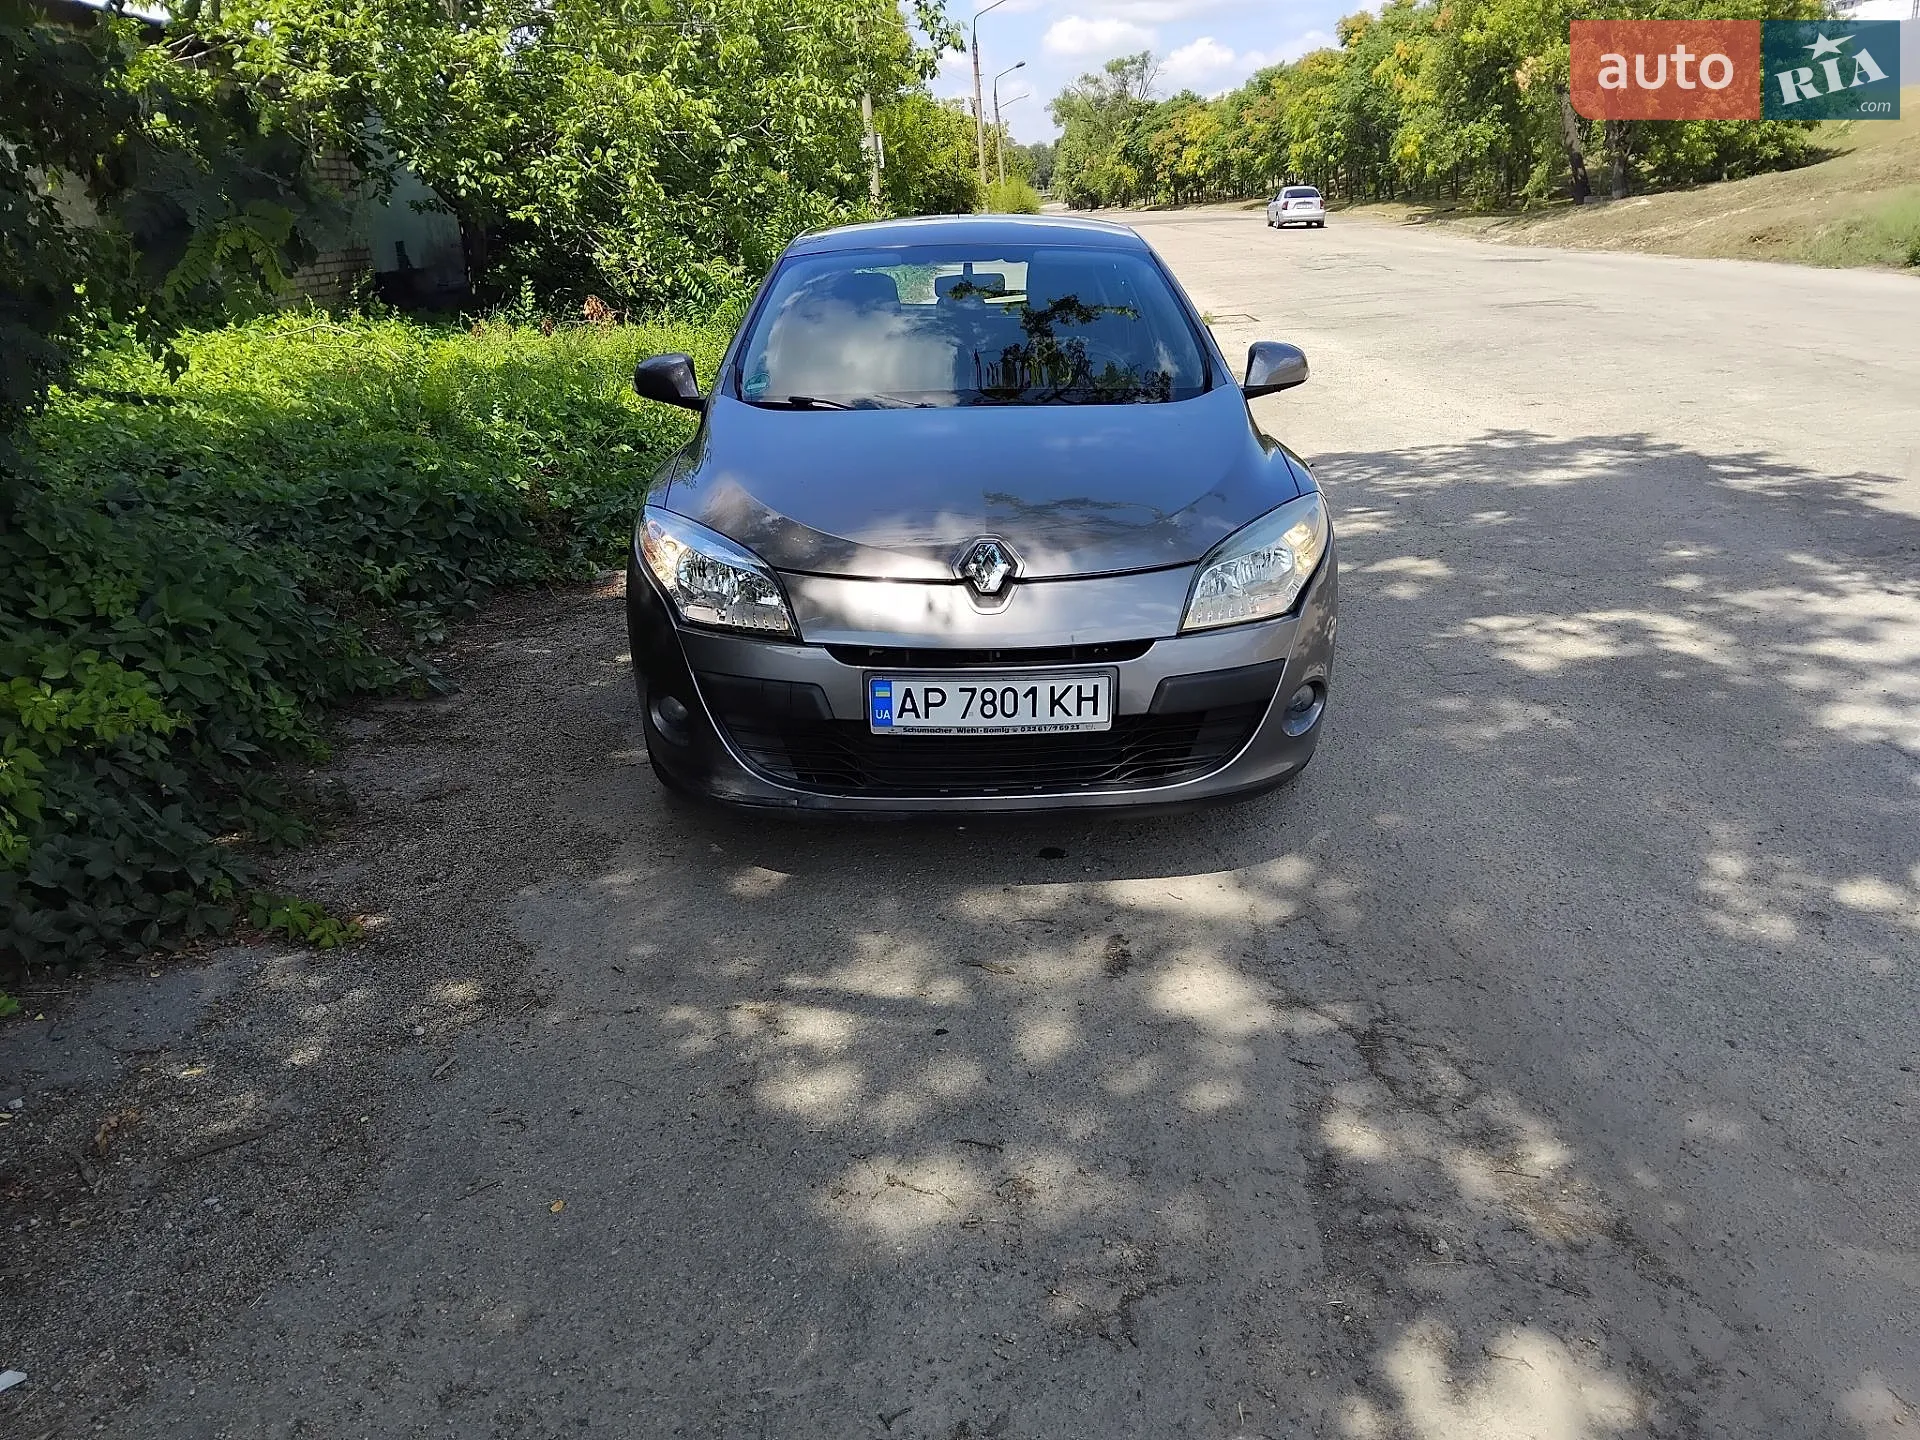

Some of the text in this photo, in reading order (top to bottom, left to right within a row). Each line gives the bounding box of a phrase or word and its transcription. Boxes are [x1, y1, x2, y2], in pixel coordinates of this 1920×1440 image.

[897, 684, 1099, 719] AP 7801 KH
[875, 709, 891, 719] UA
